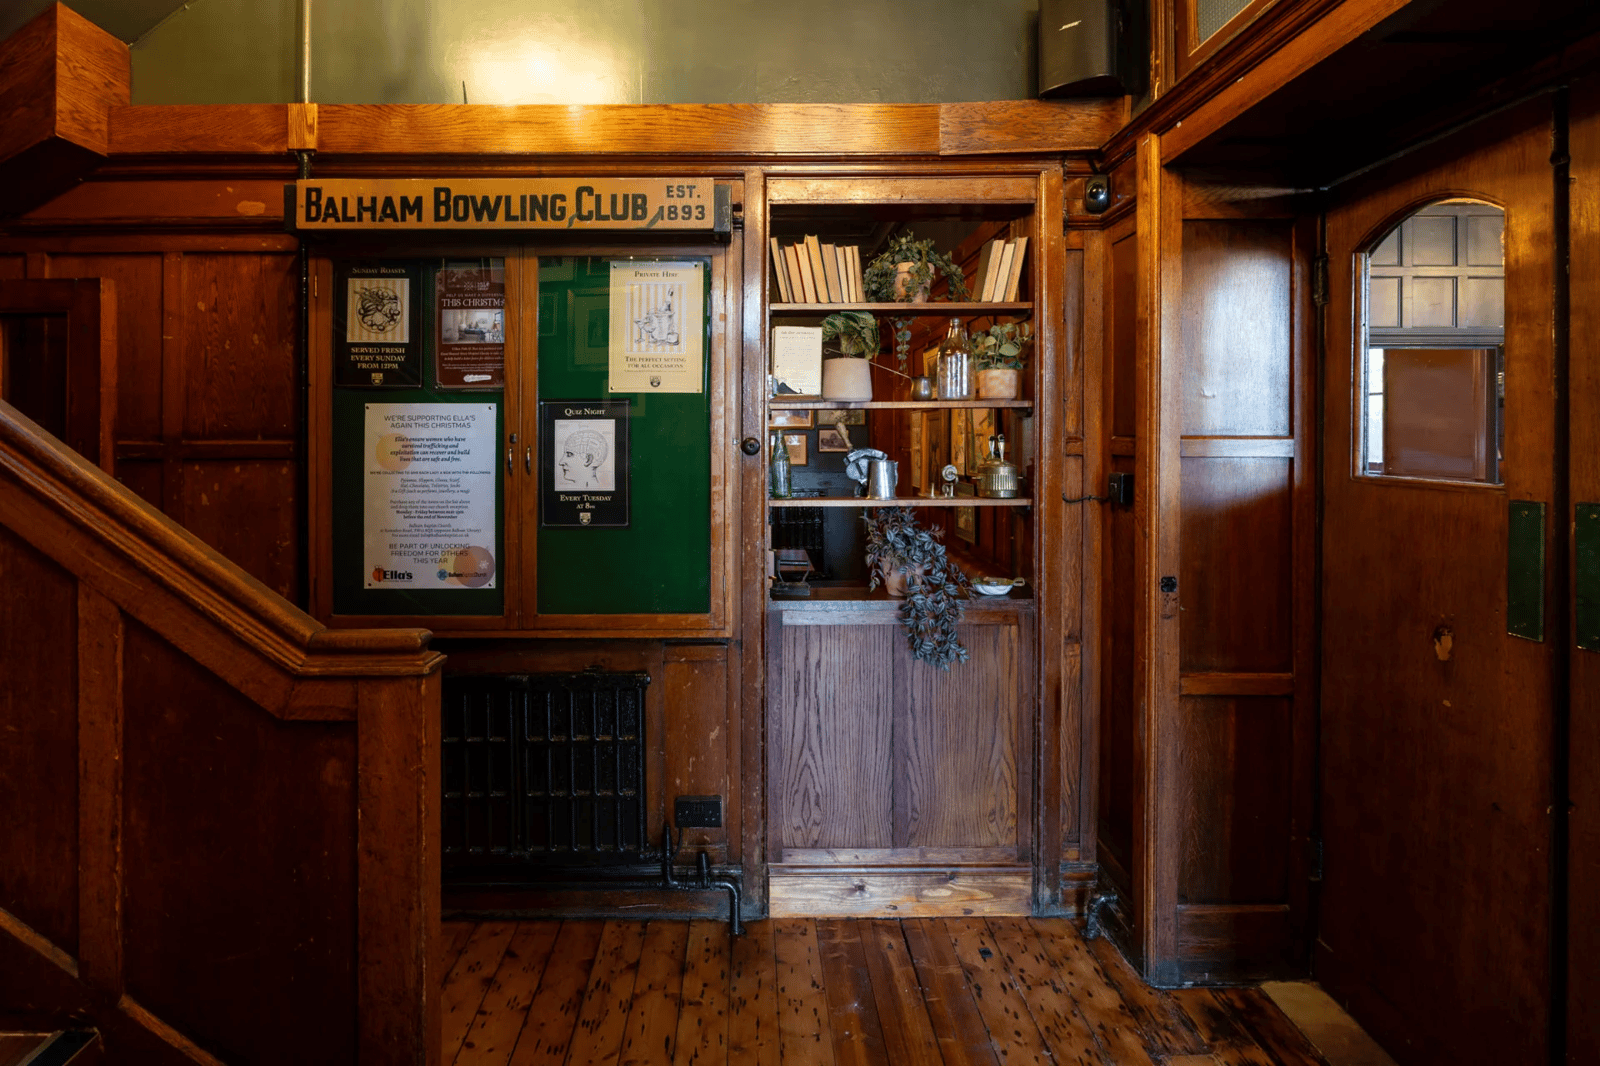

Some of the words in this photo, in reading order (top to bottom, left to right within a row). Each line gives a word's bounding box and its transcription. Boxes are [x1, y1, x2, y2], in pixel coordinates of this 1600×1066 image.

[666, 185, 701, 198] EST.
[305, 186, 423, 222] BALHAM
[434, 186, 567, 222] BOWLING
[575, 186, 648, 222] CLUB
[660, 205, 706, 220] 1893
[441, 298, 461, 307] THIS
[383, 570, 413, 580] Ella's
